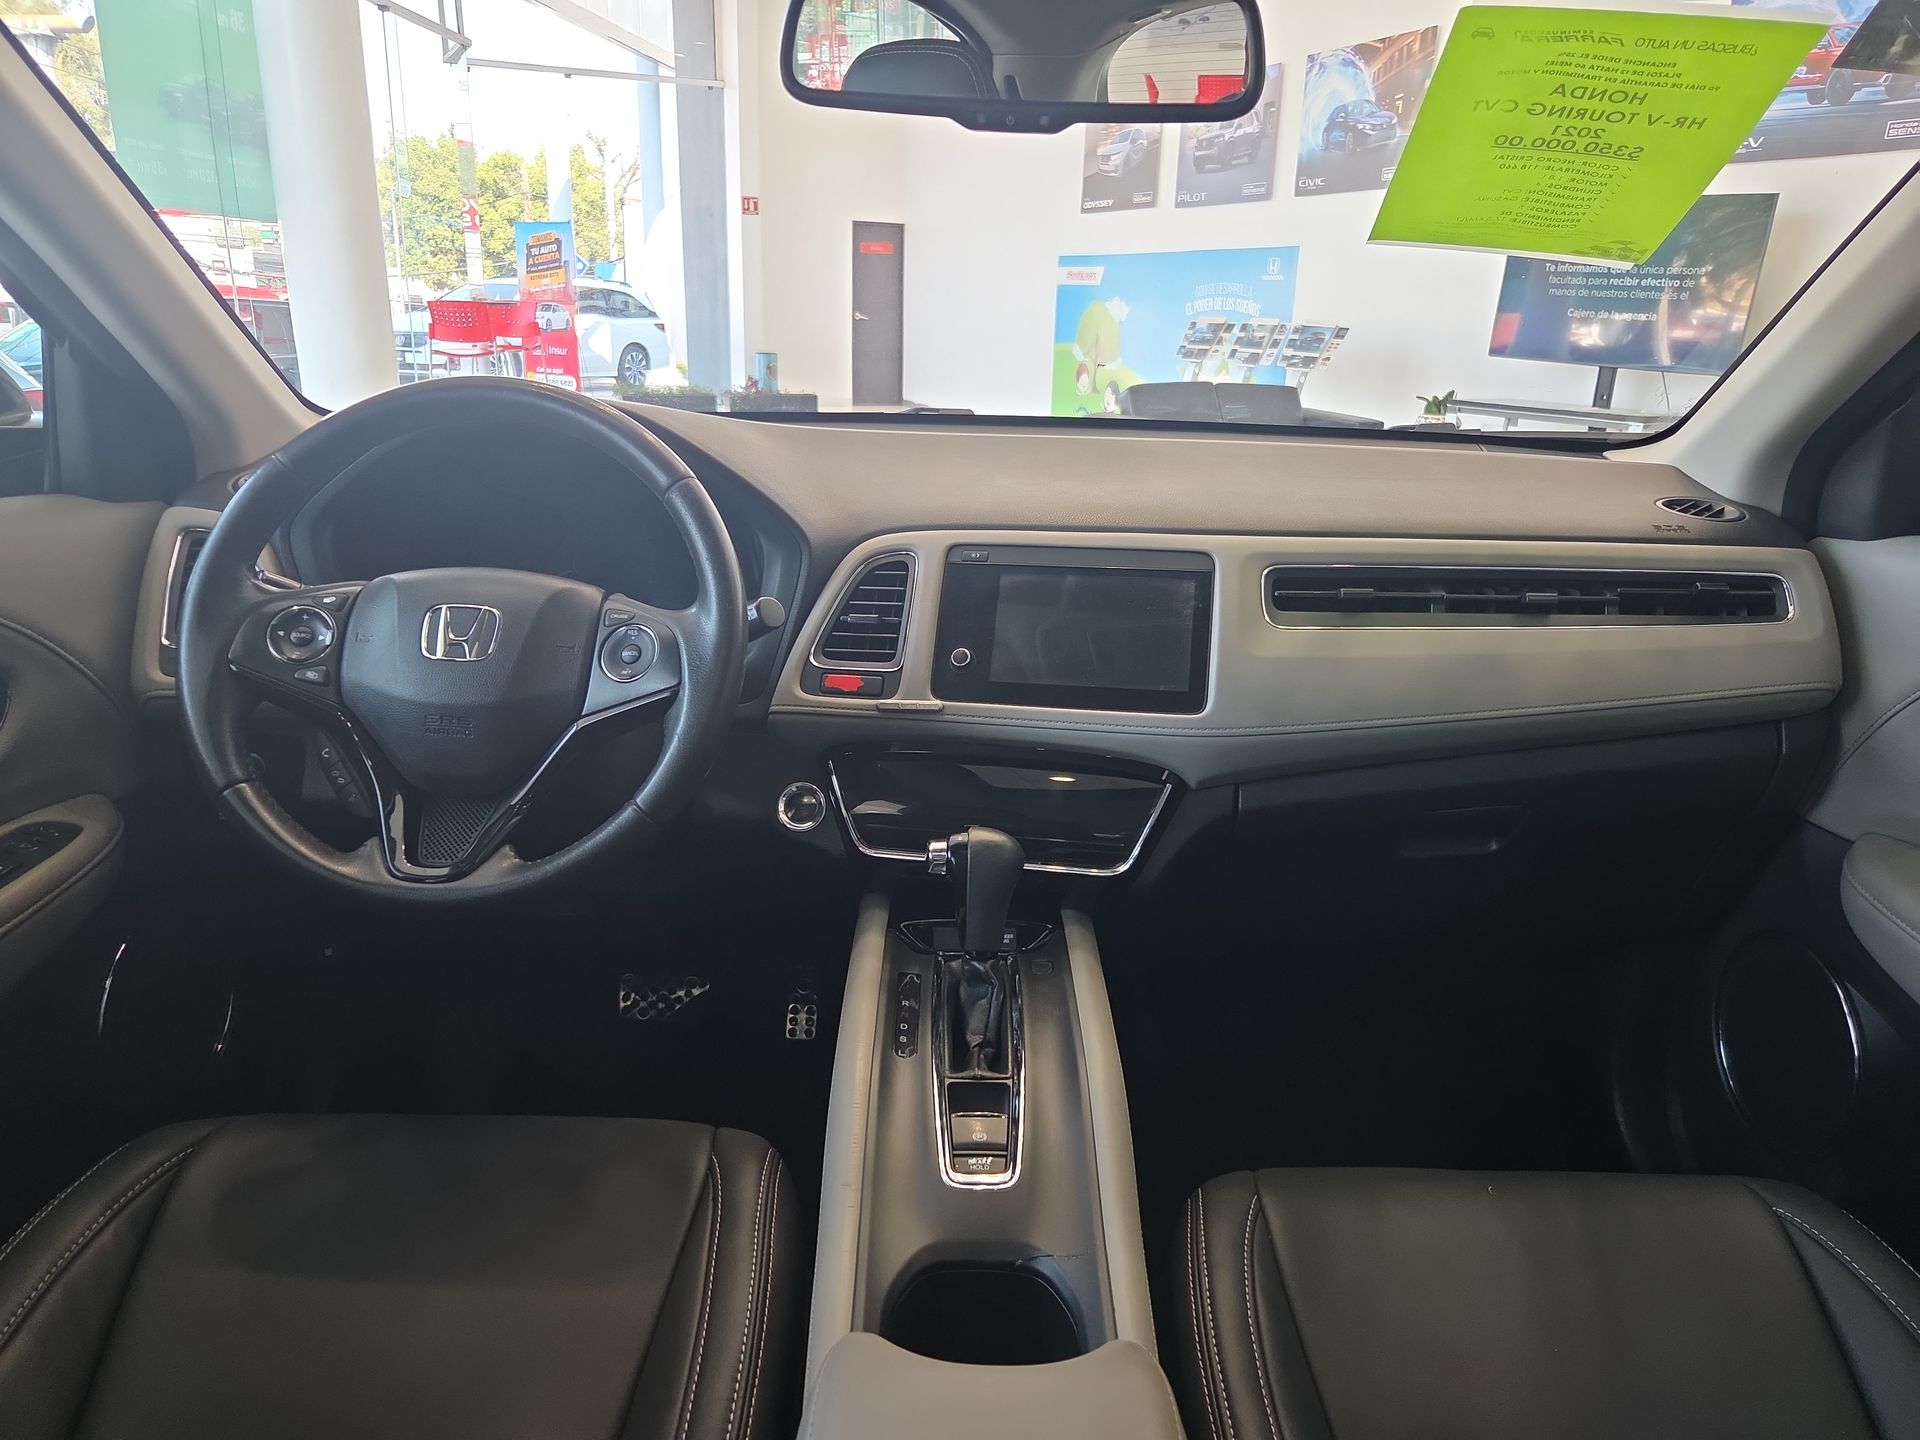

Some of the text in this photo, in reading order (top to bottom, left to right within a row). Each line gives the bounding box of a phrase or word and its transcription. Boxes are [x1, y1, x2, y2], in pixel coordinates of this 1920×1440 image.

[1299, 177, 1327, 187] CIVIC
[1177, 192, 1208, 203] PILOT
[1083, 199, 1114, 209] ODYSSEY
[530, 244, 557, 256] TU AUTO
[534, 251, 560, 263] CUENTA
[1545, 263, 1557, 272] Te
[1557, 263, 1608, 273] informamos
[1666, 266, 1705, 277] persona
[1549, 275, 1695, 288] facultada para recibir efectivo de
[1549, 288, 1577, 296] manos
[1577, 287, 1590, 297] de
[1591, 288, 1628, 298] nuestros
[1630, 289, 1662, 299] clientes
[1680, 290, 1690, 300] el
[1185, 297, 1261, 317] EL PODER DE LOS SUEÑOS
[1567, 308, 1657, 322] Cajero de la agencia
